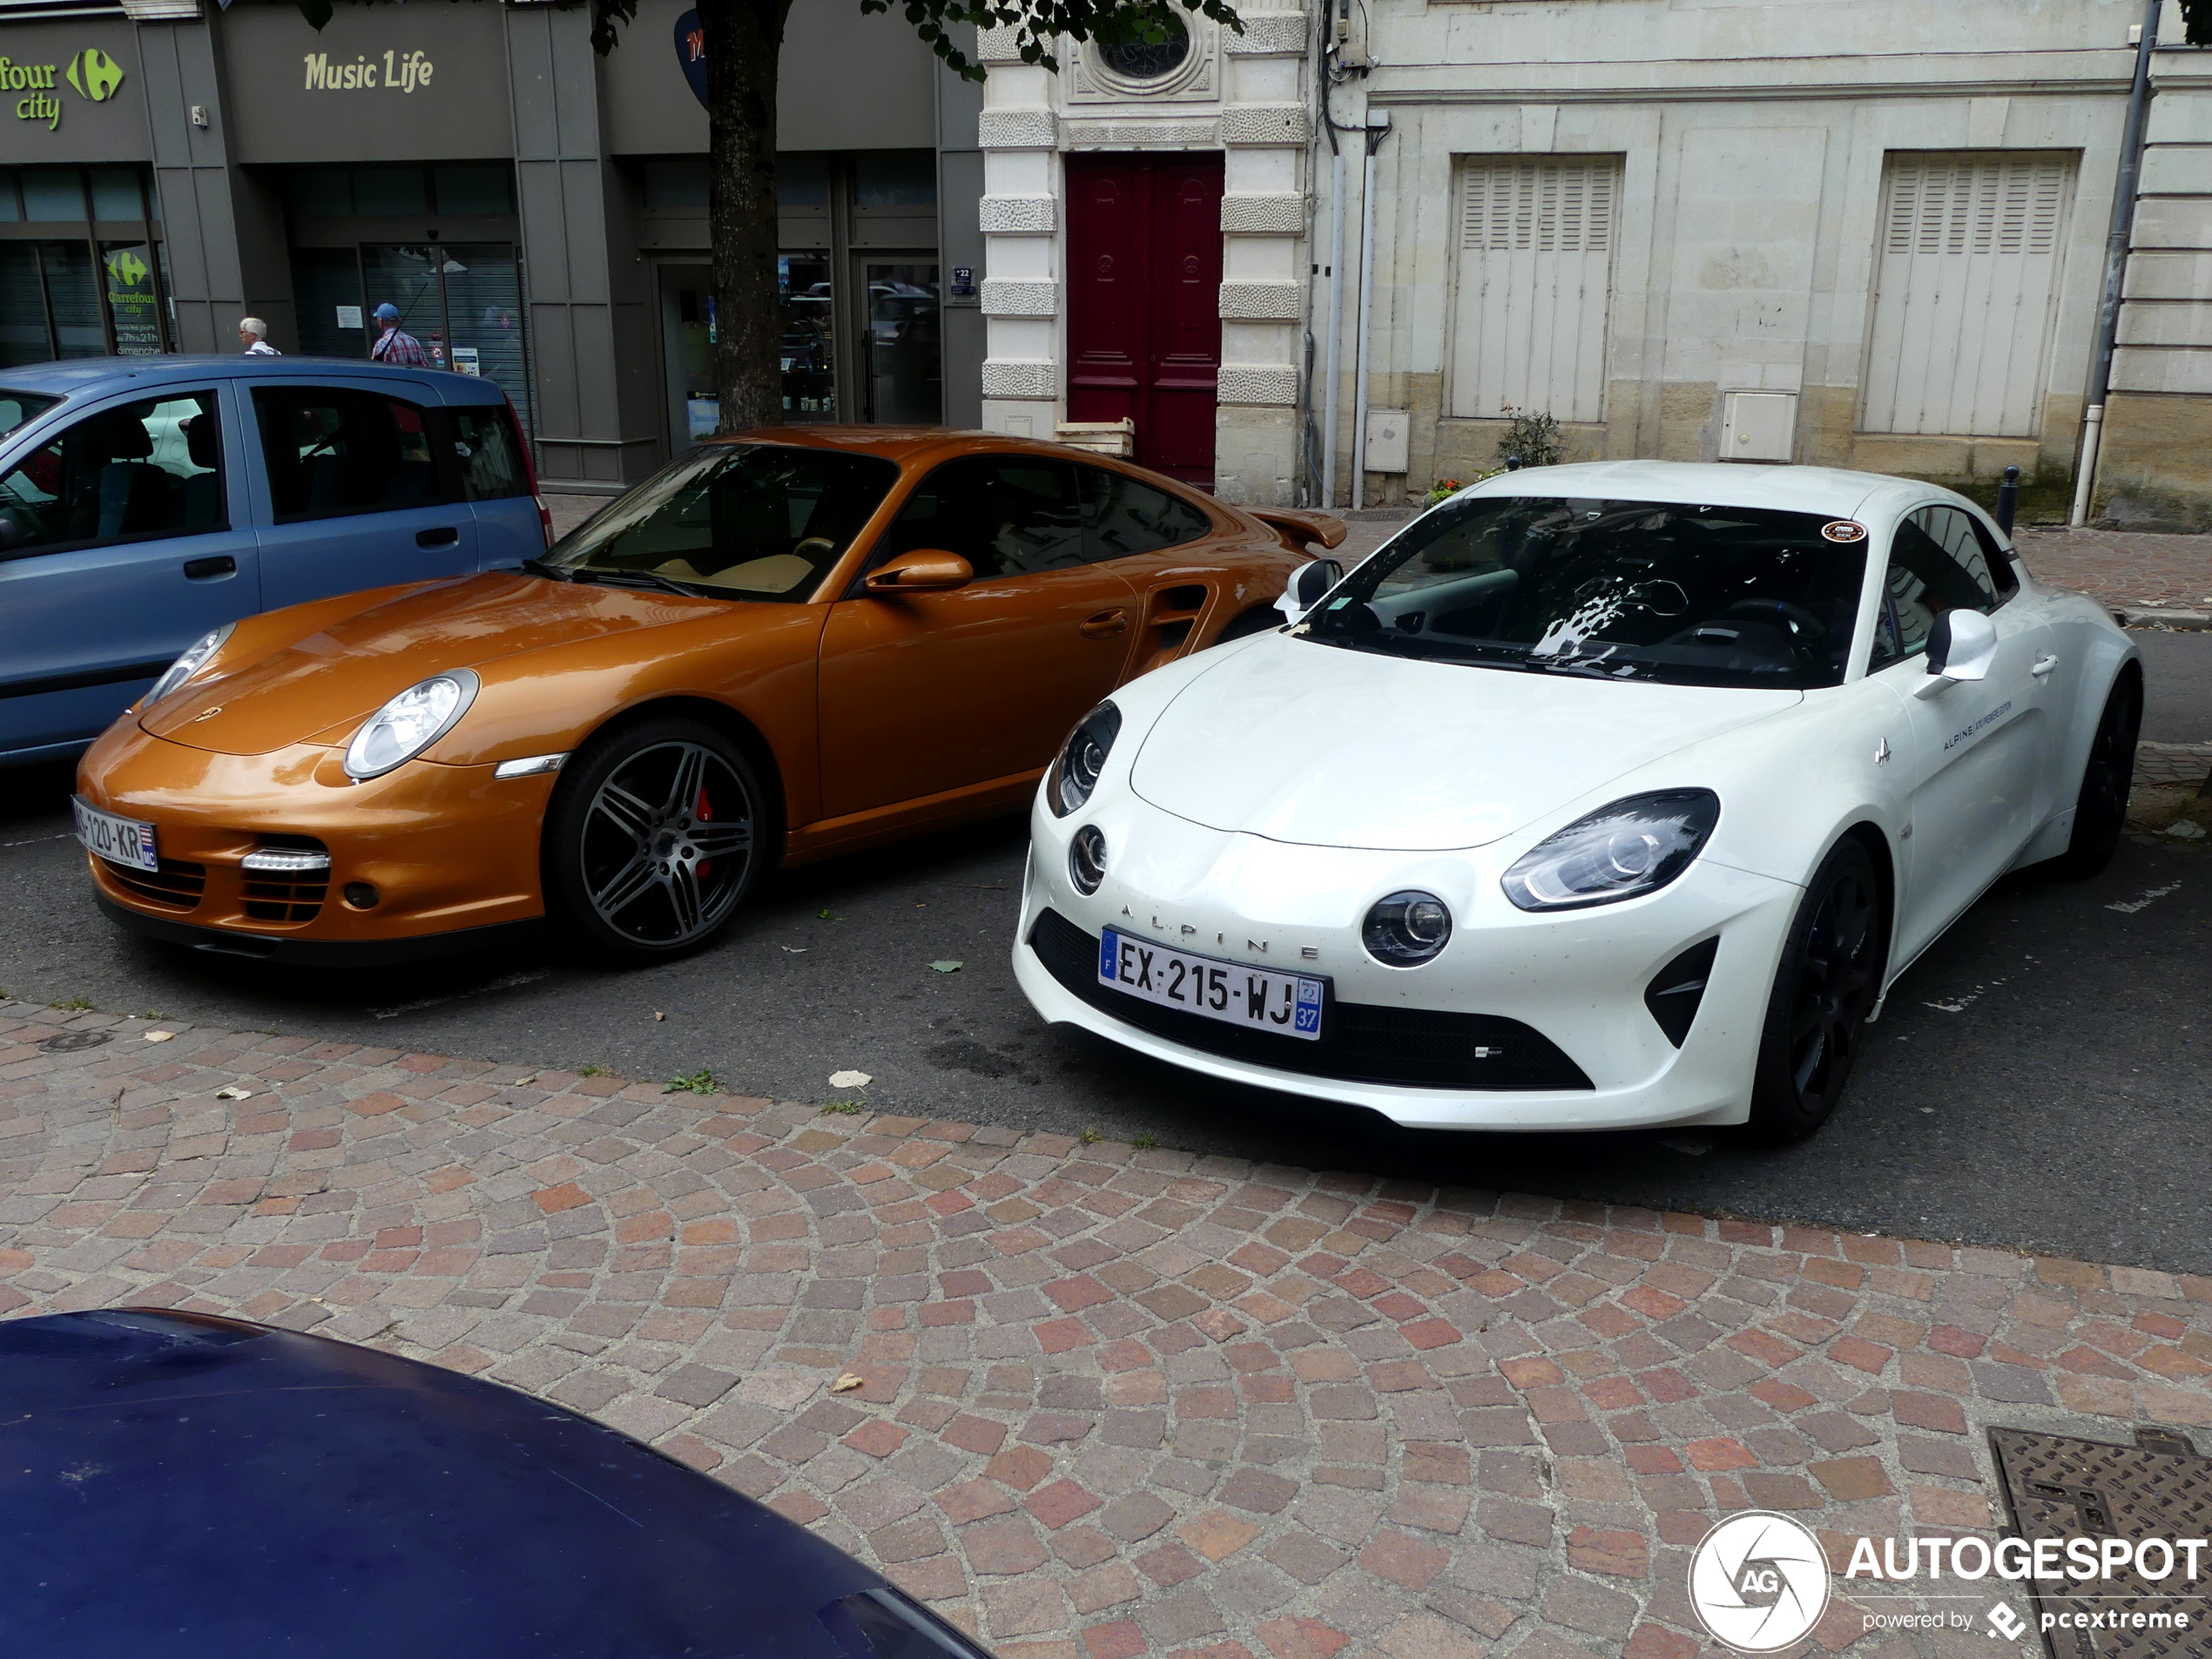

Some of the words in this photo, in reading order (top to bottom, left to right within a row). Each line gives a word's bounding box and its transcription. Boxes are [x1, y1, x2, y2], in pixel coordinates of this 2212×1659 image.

[304, 53, 377, 90] Music
[383, 50, 434, 94] Life
[17, 92, 60, 130] city
[125, 305, 142, 317] city
[140, 333, 158, 343] 21h
[1943, 725, 1973, 752] ALPINE
[143, 851, 156, 867] MC
[1121, 904, 1318, 960] ALPINE
[1105, 959, 1111, 970] F
[1119, 941, 1292, 1025] EX-215-WJ
[1297, 1008, 1318, 1028] 37
